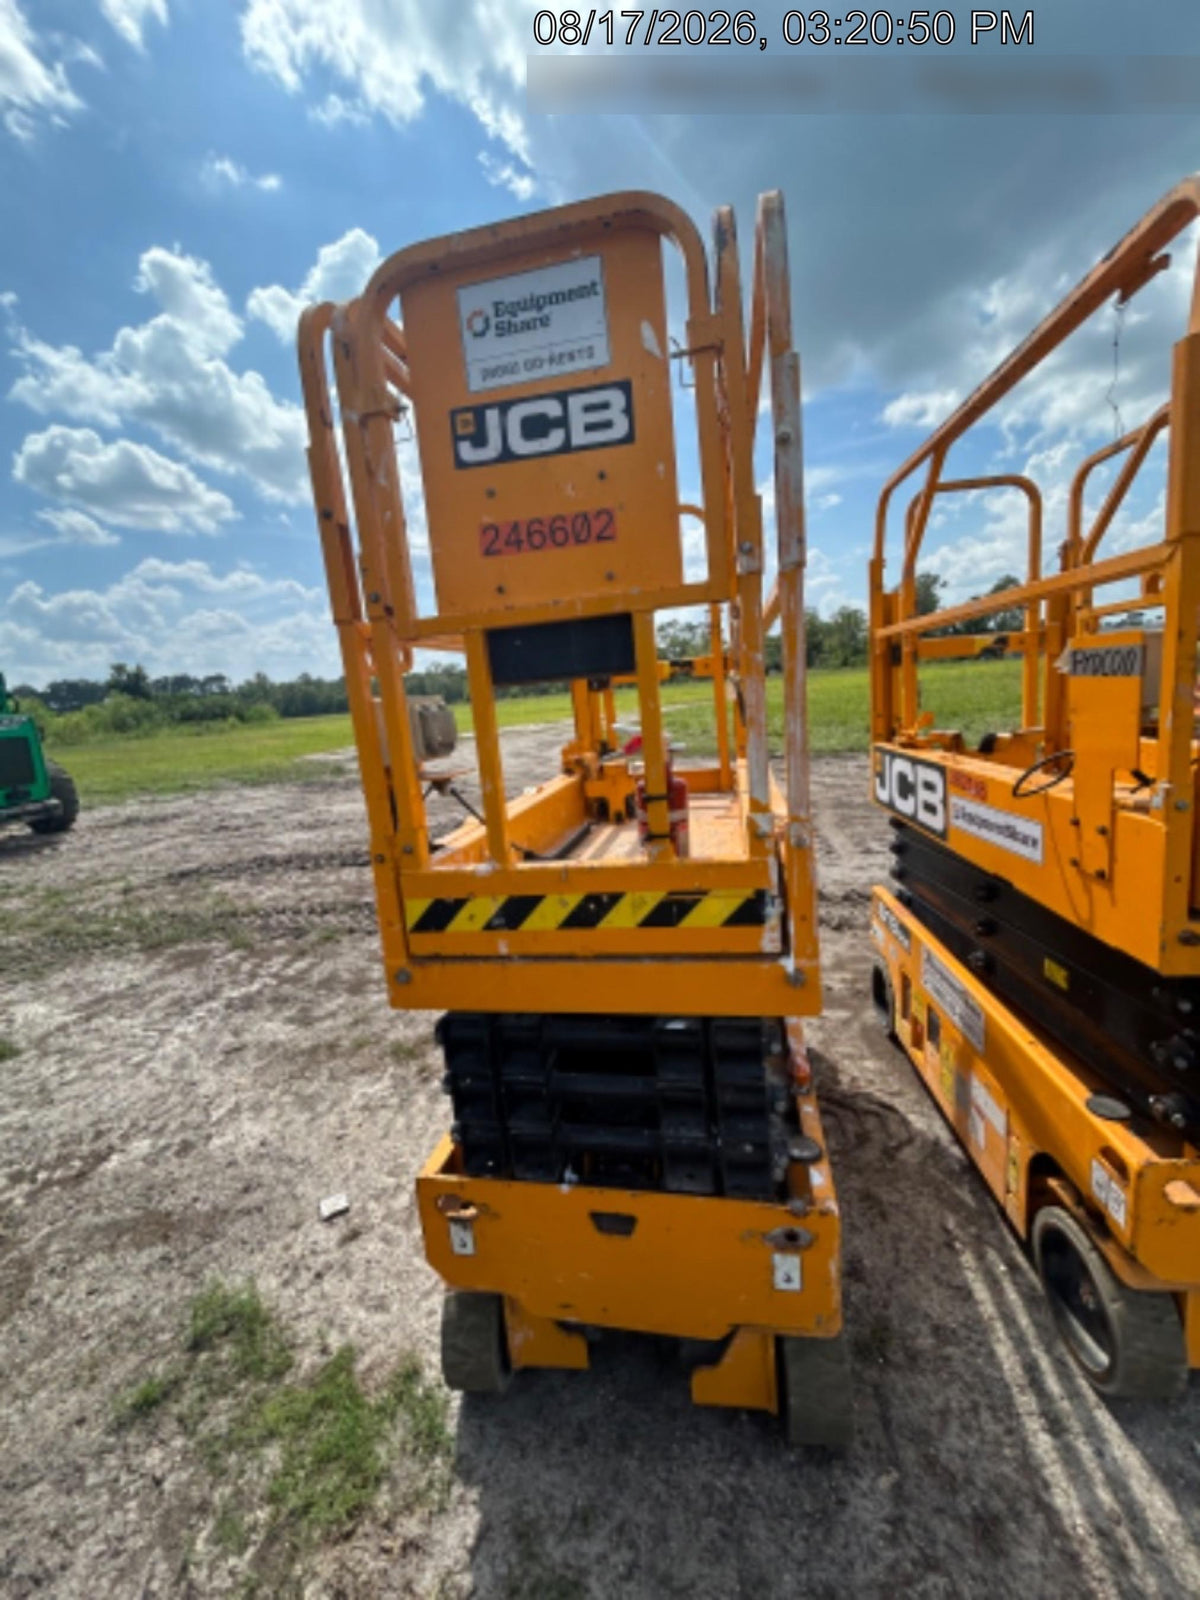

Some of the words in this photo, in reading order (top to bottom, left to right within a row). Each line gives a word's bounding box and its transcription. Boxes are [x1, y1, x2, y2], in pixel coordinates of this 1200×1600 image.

[493, 281, 599, 318] Equipment
[495, 314, 551, 338] Share
[457, 387, 630, 464] JCB
[482, 508, 616, 557] 246602
[875, 754, 945, 834] JCB
